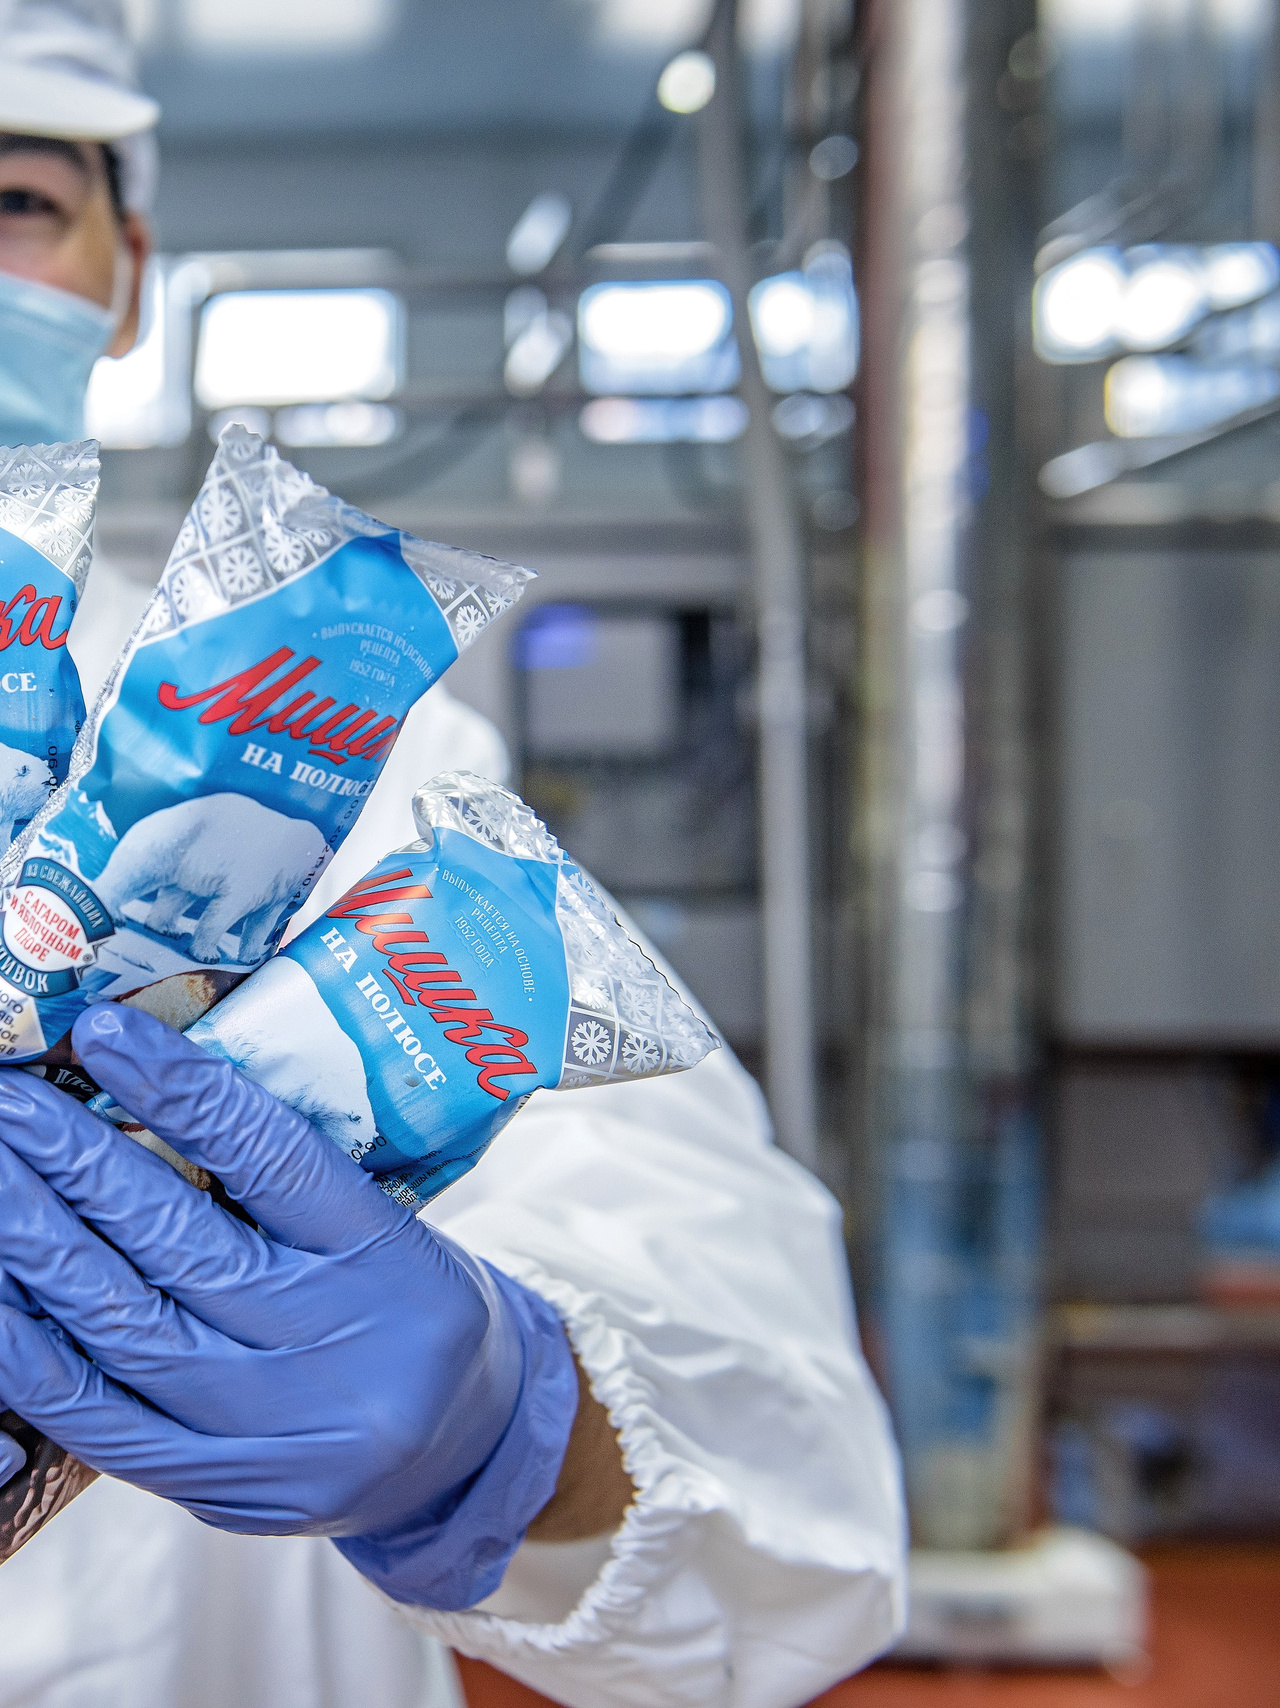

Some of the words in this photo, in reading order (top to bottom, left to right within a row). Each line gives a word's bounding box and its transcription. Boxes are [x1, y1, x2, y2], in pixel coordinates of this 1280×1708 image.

[320, 621, 394, 643] ВЫПУСКАЕТСЯ
[360, 639, 401, 667] РЕЦЕПТА
[240, 742, 285, 776] НА
[23, 890, 35, 904] С
[33, 898, 80, 941] АГАРОМ
[39, 864, 106, 929] СВЕЖАЙШИХ
[9, 894, 19, 910] И
[17, 904, 84, 961] ЯБЛОЧНЫМ
[13, 927, 50, 963] ПЮРЕ
[441, 869, 510, 931] ВЫПУСКАЕТСЯ
[506, 931, 520, 948] НА
[514, 948, 535, 994] ОСНОВЕ
[454, 916, 476, 941] 1952
[471, 938, 495, 968] ГОДА
[470, 908, 508, 954] РЕЦЕПТА
[320, 927, 359, 974] НА
[355, 972, 447, 1091] ПОЛЮСЕ
[326, 868, 538, 1102] Мишка
[6, 1046, 17, 1056] В
